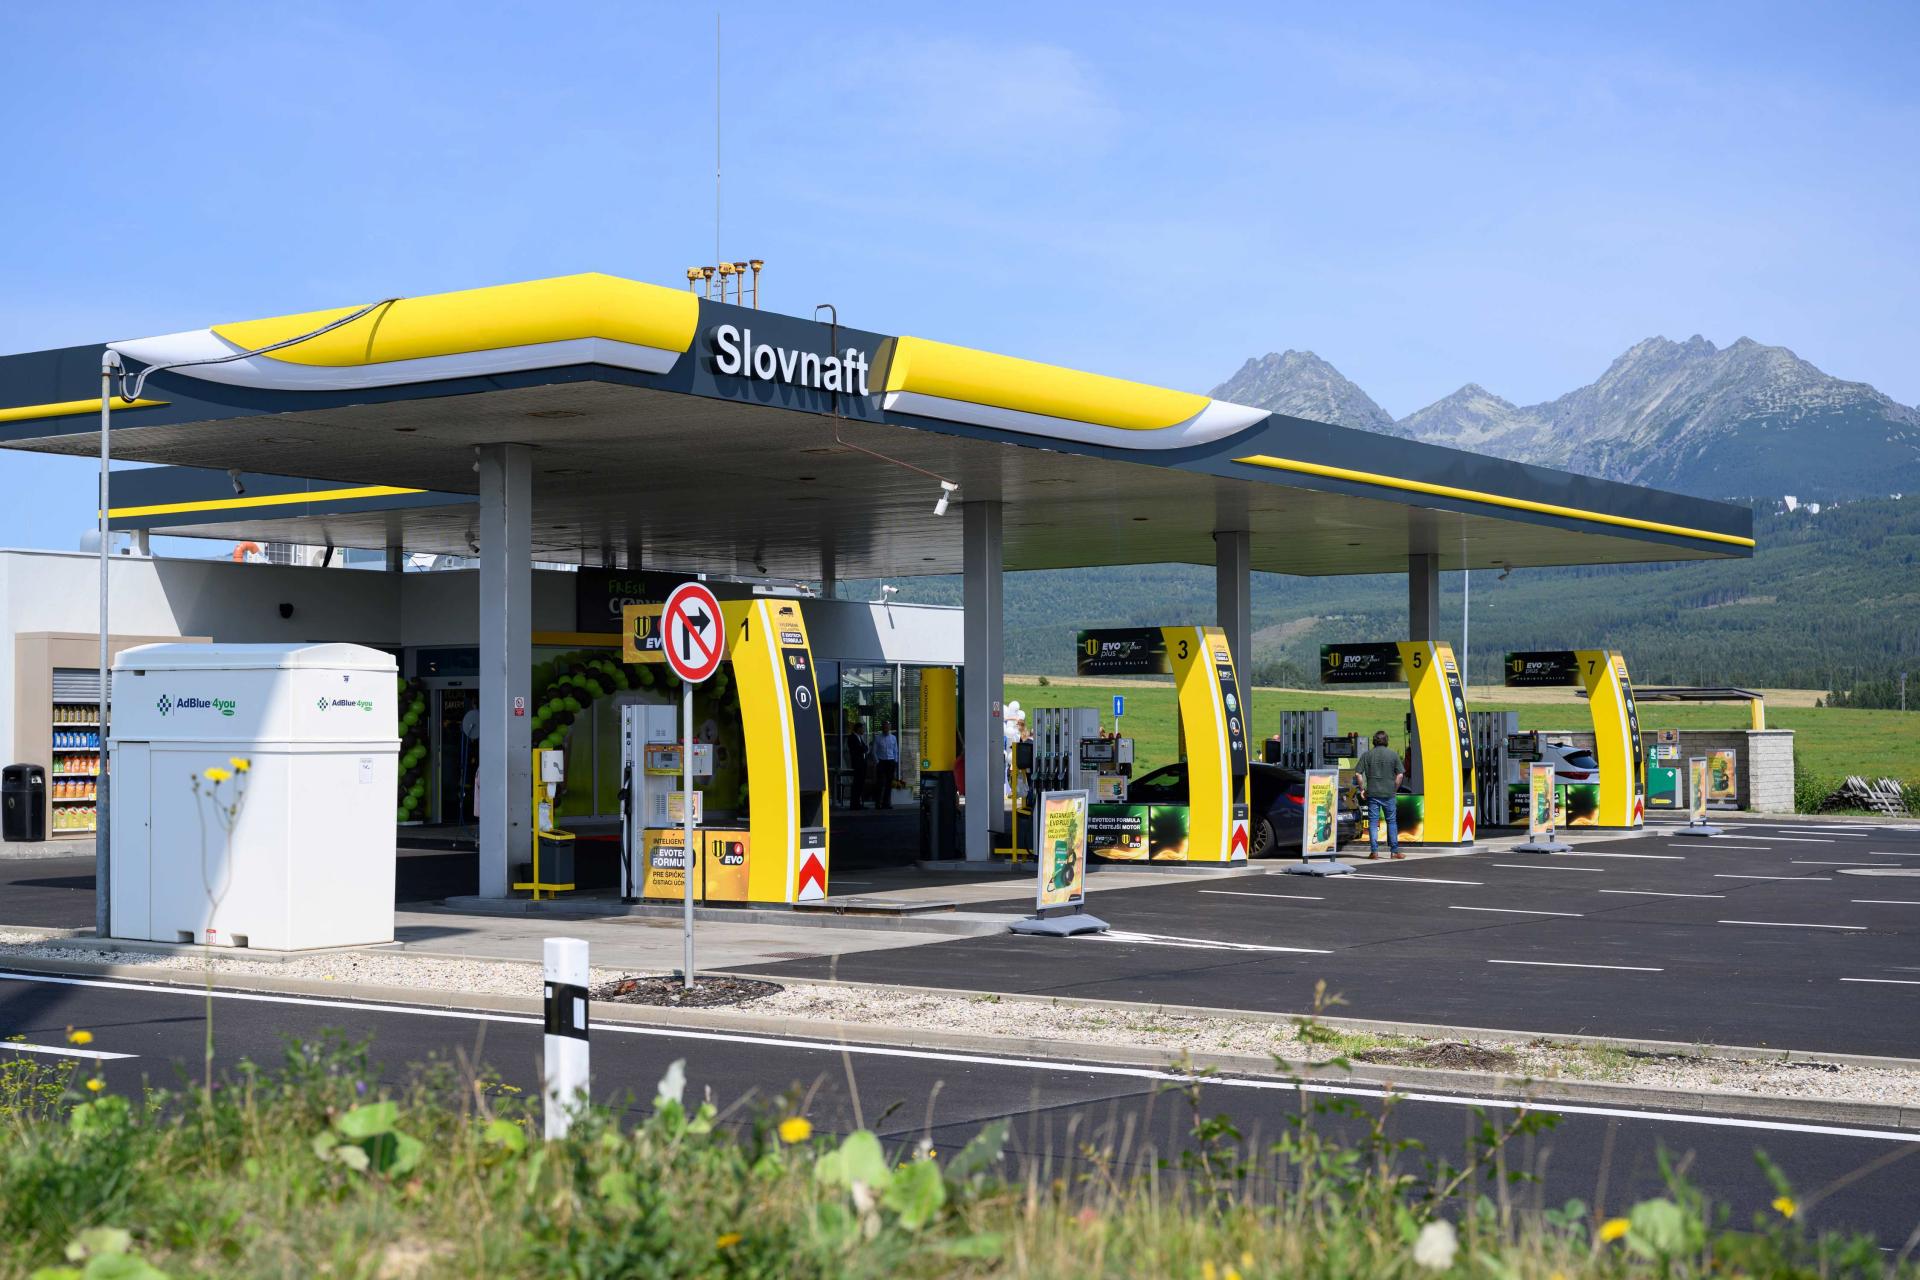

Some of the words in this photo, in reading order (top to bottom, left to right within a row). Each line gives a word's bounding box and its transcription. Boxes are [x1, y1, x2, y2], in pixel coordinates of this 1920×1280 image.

[716, 324, 868, 396] Slovnaft
[741, 617, 749, 641] 1
[646, 637, 662, 648] EV
[1102, 642, 1121, 651] EVO
[1101, 649, 1116, 658] plus
[1178, 640, 1188, 659] 3
[1344, 655, 1361, 663] EVO
[1413, 652, 1422, 669] 5
[1343, 661, 1357, 669] plus
[1588, 661, 1595, 675] 7
[800, 692, 807, 702] D
[724, 855, 743, 864] EVO
[665, 870, 686, 878] ŠPIČKO
